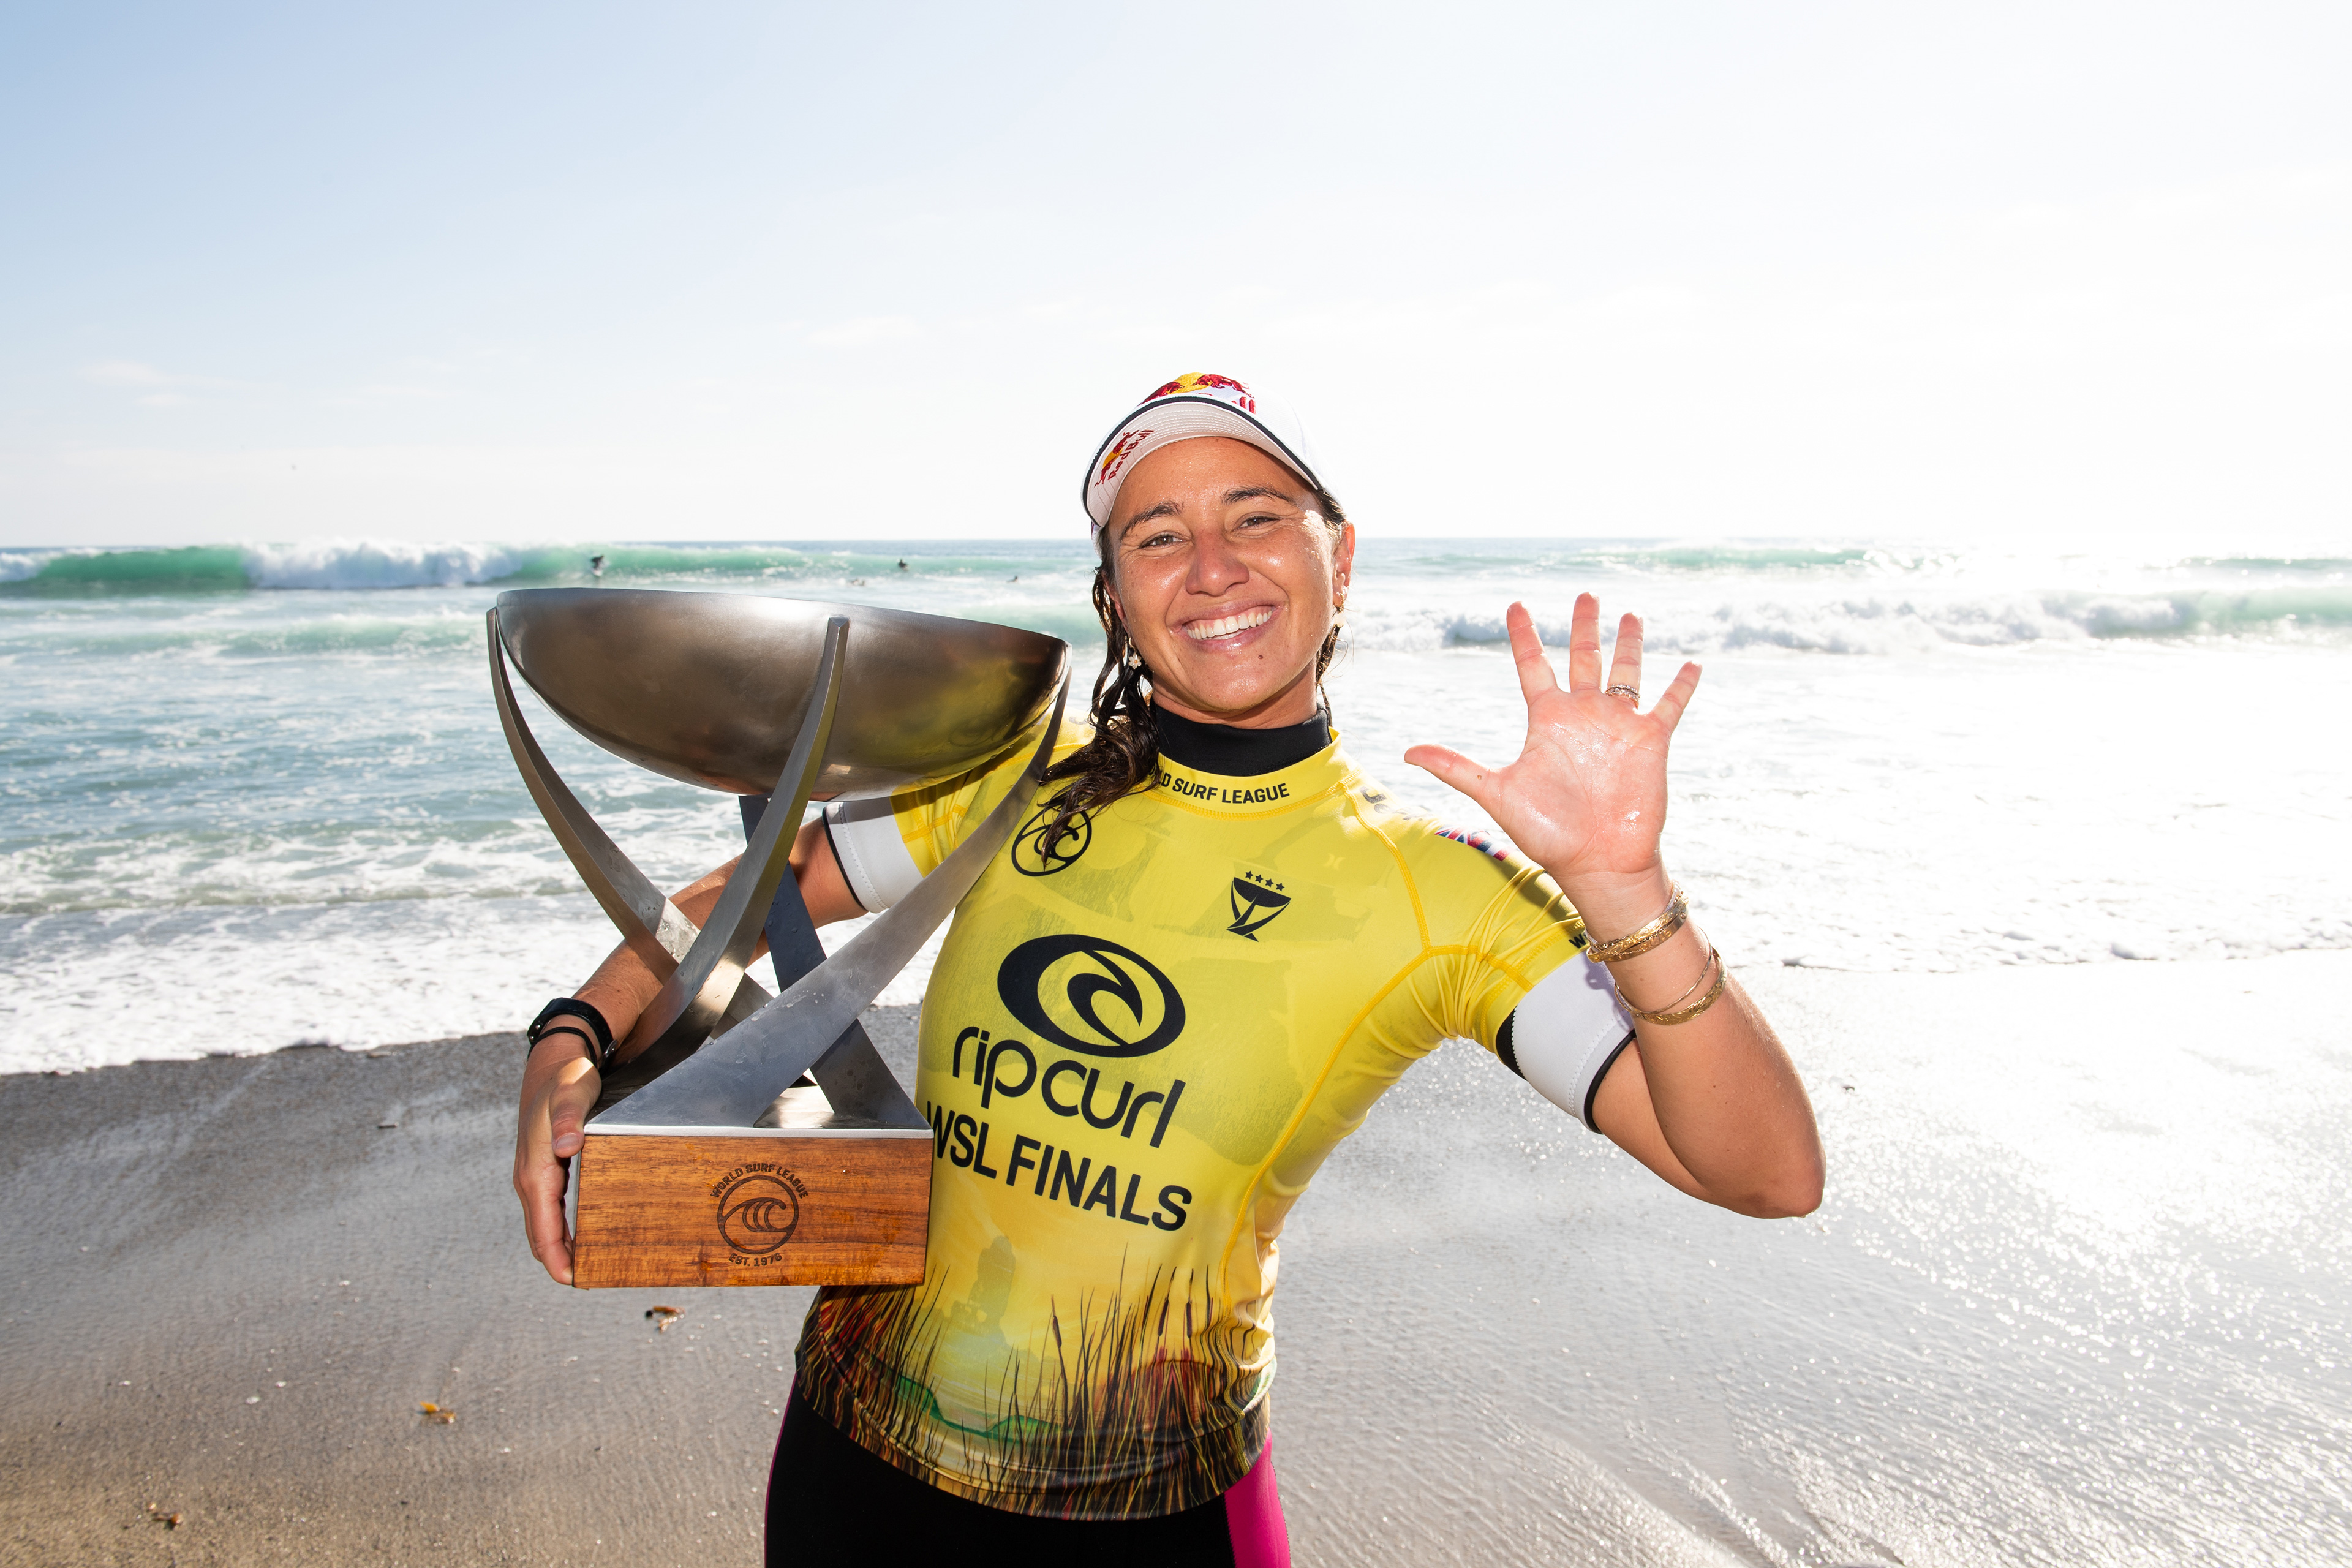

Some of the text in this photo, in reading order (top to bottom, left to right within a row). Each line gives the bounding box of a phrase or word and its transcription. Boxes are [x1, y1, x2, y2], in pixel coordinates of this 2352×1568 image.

[1172, 778, 1218, 800] SURF
[1221, 783, 1289, 804] LEAGUE
[952, 1026, 1186, 1148] rip curl
[710, 1163, 808, 1199] WORLD SURF LEAGUE
[927, 1100, 1193, 1231] WSL FINALS
[728, 1252, 782, 1267] EST. 1976
